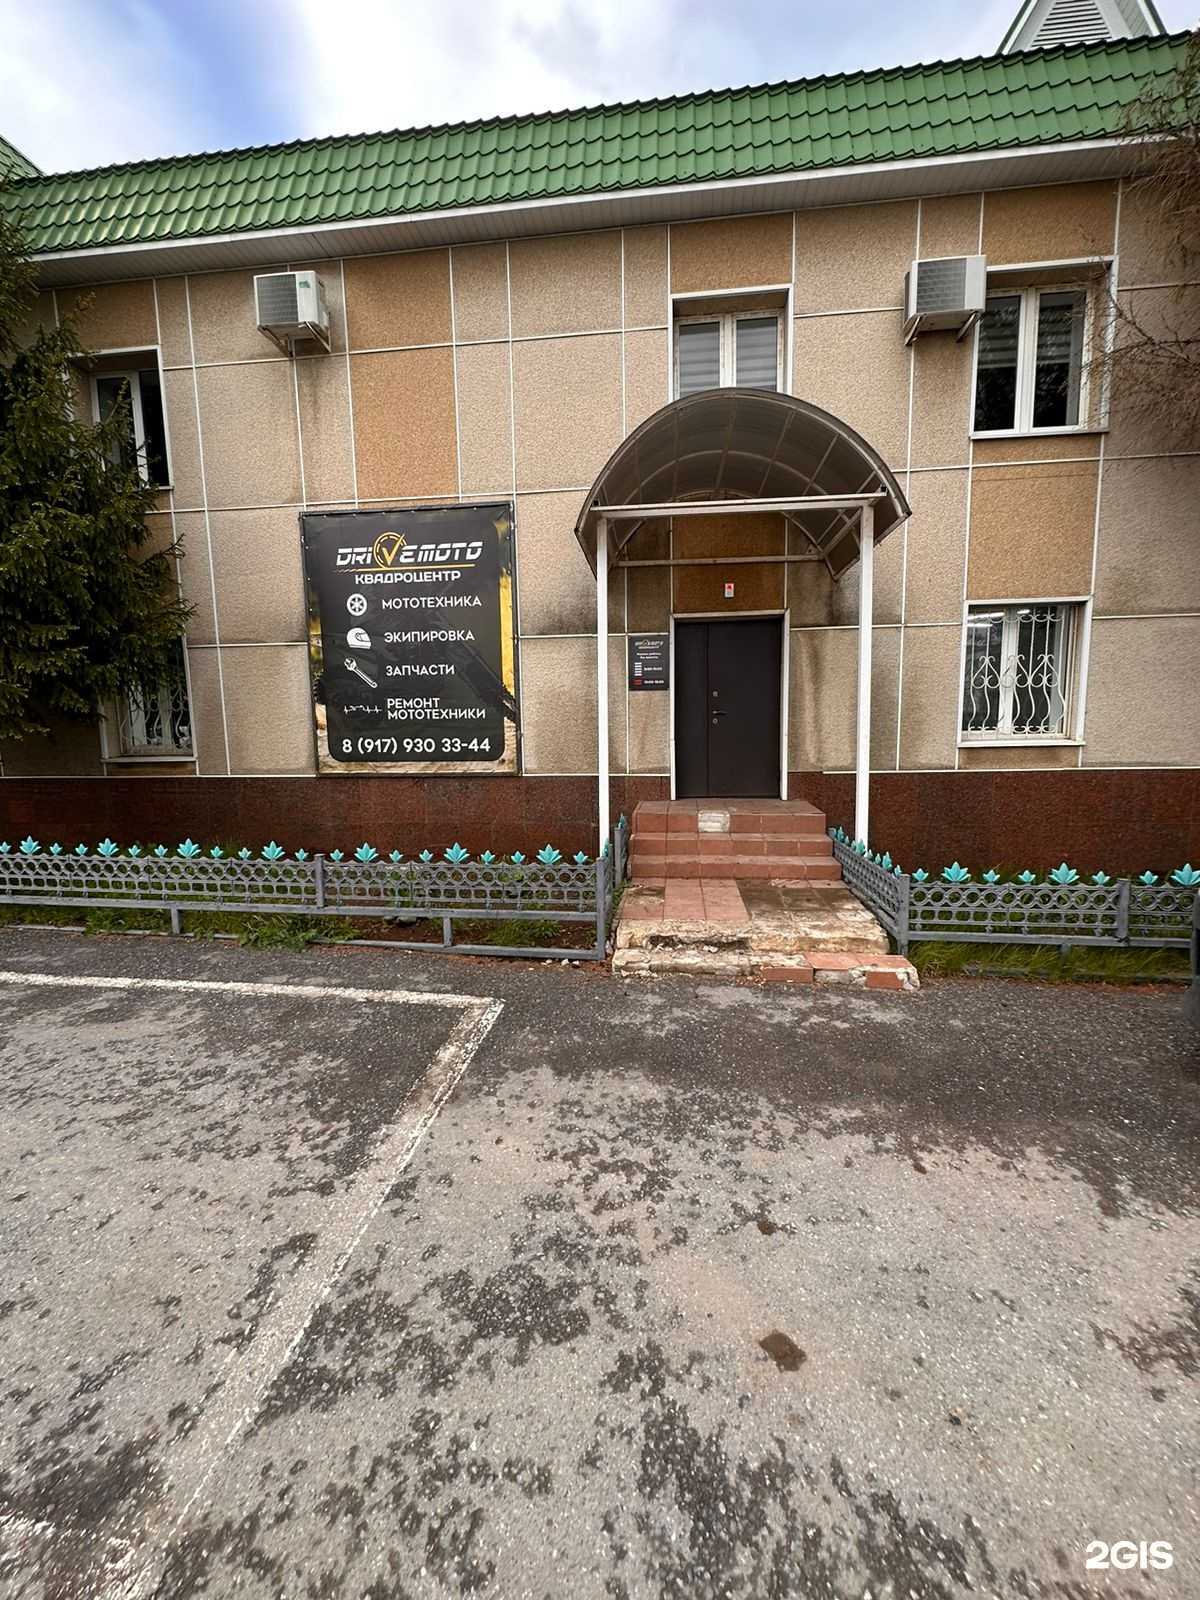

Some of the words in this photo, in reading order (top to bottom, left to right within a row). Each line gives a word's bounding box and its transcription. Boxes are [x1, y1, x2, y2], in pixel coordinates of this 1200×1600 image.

[355, 571, 461, 585] КВАДРОЦЕНТР
[382, 596, 482, 610] МОТОТЕХНИКА
[384, 630, 475, 643] ЭКИПИРОВКА
[386, 664, 455, 676] ЗАПЧАСТИ
[387, 698, 440, 709] РЕМОНТ
[388, 708, 486, 720] МОТОТЕХНИКИ
[342, 740, 352, 753] 8
[357, 737, 397, 755] (917)
[403, 738, 435, 753] 930
[441, 738, 490, 752] 33-44
